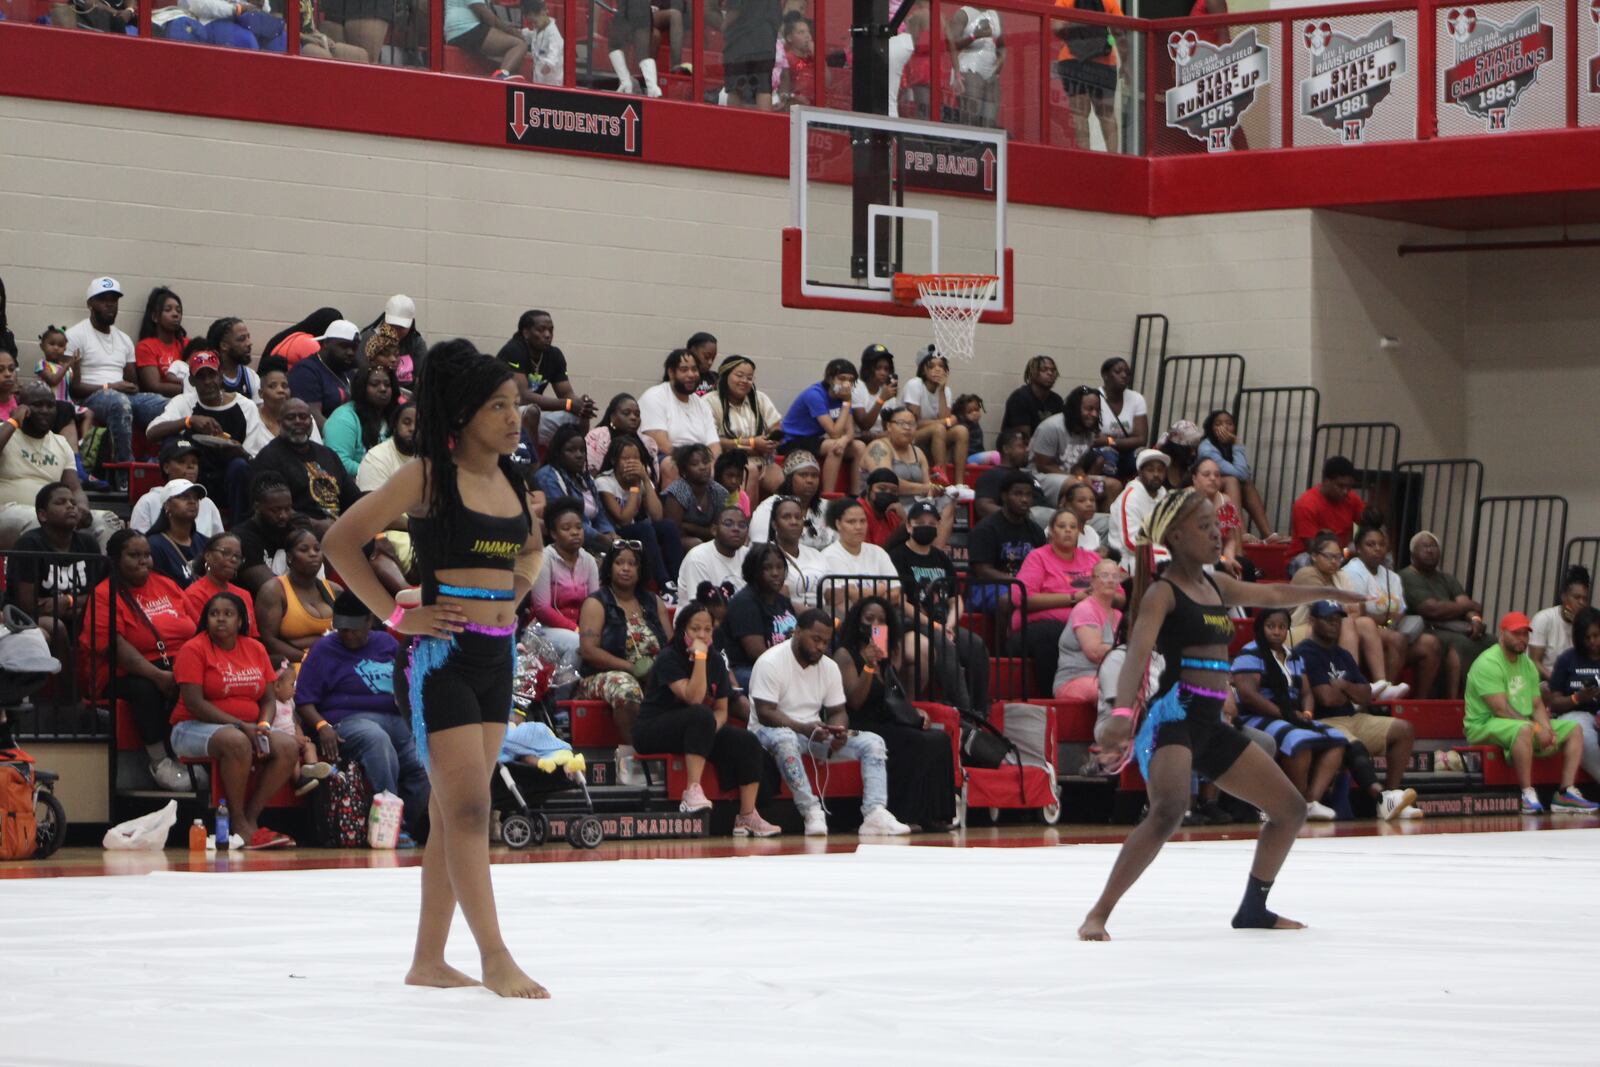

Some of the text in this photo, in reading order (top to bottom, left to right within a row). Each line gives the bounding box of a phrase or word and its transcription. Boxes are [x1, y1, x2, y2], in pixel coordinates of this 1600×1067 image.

[1316, 35, 1390, 75] RAMS FOOTBALL
[1459, 47, 1482, 61] GIRLS
[1484, 37, 1507, 52] TRACK
[1515, 24, 1537, 37] FIELD
[1475, 42, 1522, 73] STATE
[1202, 61, 1224, 77] TRACK
[1232, 46, 1253, 61] FIELD
[1331, 53, 1375, 84] STATE
[1452, 47, 1546, 97] CHAMPIONS
[1177, 70, 1260, 118] RUNNER-UP
[1197, 63, 1239, 94] STATE
[1310, 60, 1397, 109] RUNNER-UP
[1478, 80, 1516, 108] 1983
[1201, 100, 1234, 128] 1975
[1334, 92, 1368, 119] 1981
[529, 107, 620, 136] STUDENTS
[904, 150, 978, 177] PEP BAND
[637, 818, 703, 834] MADISON
